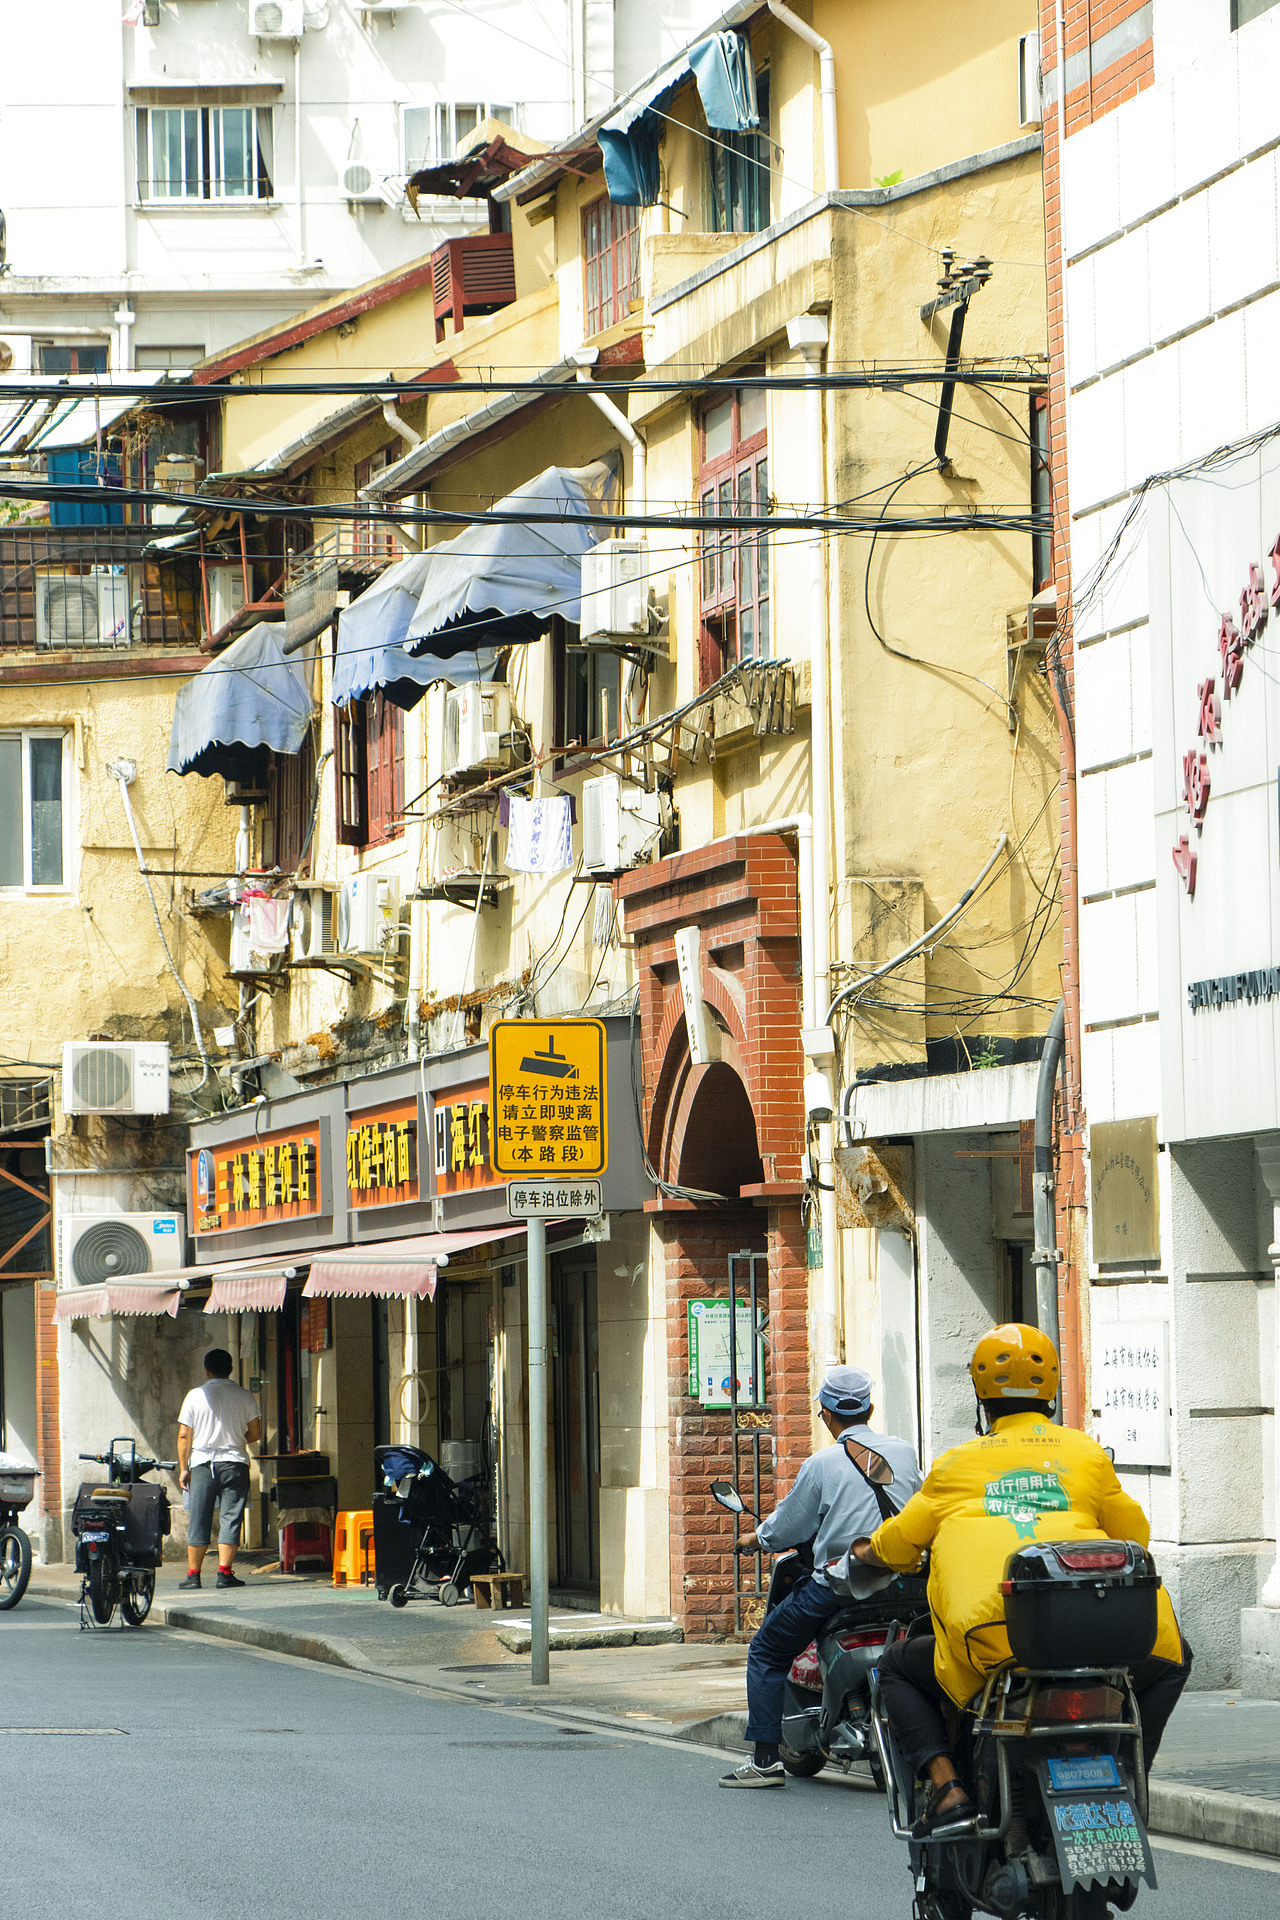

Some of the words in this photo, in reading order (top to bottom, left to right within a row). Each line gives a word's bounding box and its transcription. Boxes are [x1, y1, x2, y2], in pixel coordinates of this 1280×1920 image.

[499, 1084, 599, 1101] 停车行为违法
[503, 1104, 593, 1121] 请立即驶离
[498, 1125, 599, 1142] 电子警察监管
[346, 1119, 411, 1190] 红烧牛肉面
[514, 1189, 597, 1209] 停车泊位除外
[986, 1473, 1058, 1497] 农行信用卡
[1062, 1827, 1142, 1845] 一次充电308里
[1064, 1841, 1143, 1855] 55138706
[1068, 1857, 1145, 1869] 65106192
